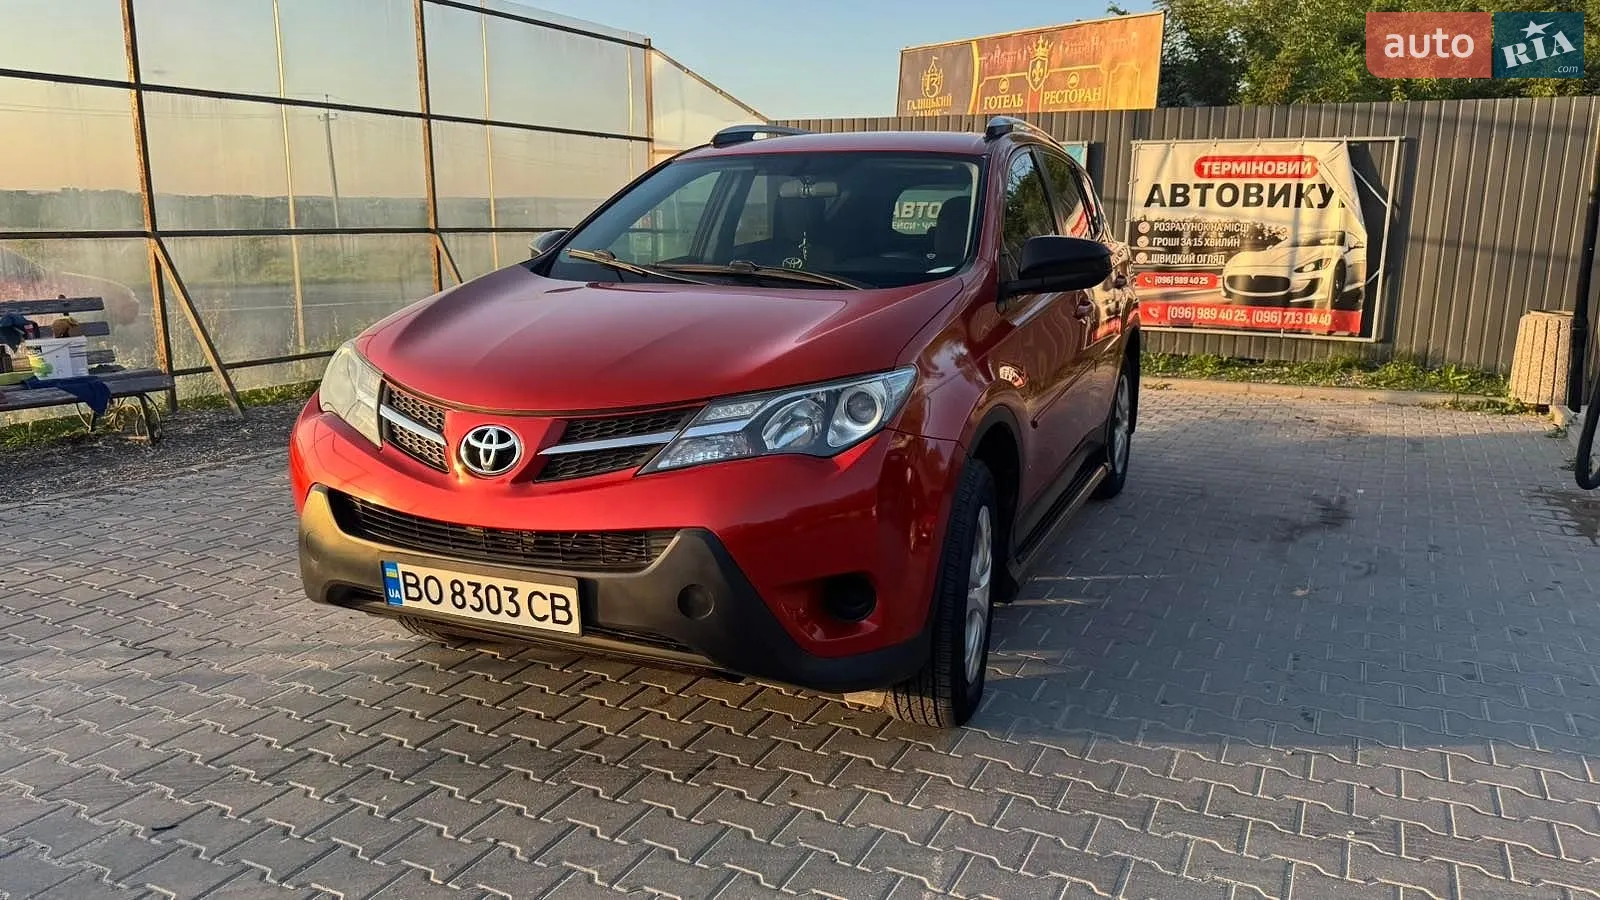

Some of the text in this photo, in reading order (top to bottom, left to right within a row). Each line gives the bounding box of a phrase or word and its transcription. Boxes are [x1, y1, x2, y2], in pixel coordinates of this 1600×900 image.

[983, 93, 1024, 110] ГОТЕЛЬ
[1043, 87, 1102, 105] РЕСТОРАН
[1201, 158, 1312, 175] ТЕРМІНОВИЙ
[1143, 182, 1346, 209] АВТОВИКУ
[1153, 222, 1249, 233] РОЗРАХУНОК НА МІСЦІ
[1152, 236, 1240, 248] ГРОШІ ЗА 15 ХВИЛИН
[1151, 253, 1225, 265] ШВИДКИЙ ОГЛЯД
[1155, 276, 1209, 285] (096) 989 40 25
[1167, 304, 1195, 320] (096)
[1196, 308, 1217, 320] 989
[1218, 309, 1233, 321] 40
[1251, 309, 1282, 325] (096)
[1283, 312, 1303, 325] 713
[1304, 313, 1318, 326] 04
[1318, 313, 1332, 326] 40
[388, 589, 401, 599] UA
[401, 570, 573, 625] BO 8303 CB
